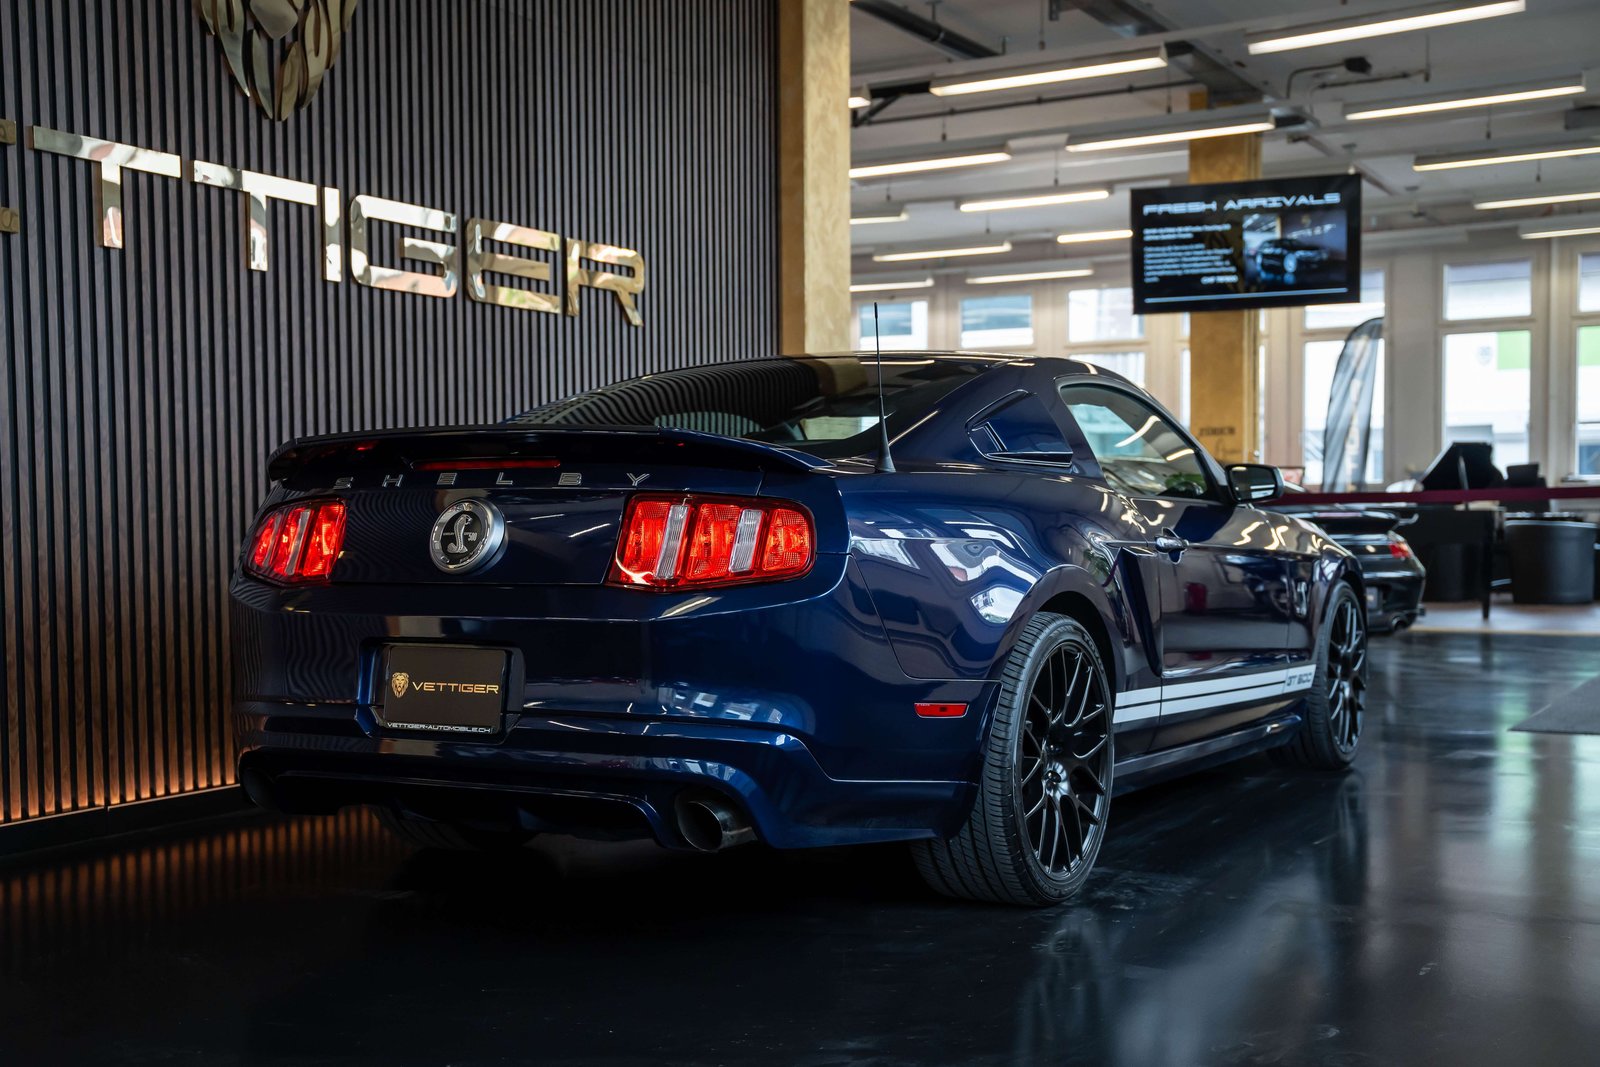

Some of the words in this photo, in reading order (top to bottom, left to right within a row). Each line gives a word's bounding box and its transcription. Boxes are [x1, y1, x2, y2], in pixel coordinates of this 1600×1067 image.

[1143, 200, 1217, 216] FRESH
[1223, 192, 1341, 212] ARRIVALS
[0, 118, 645, 327] TTIGER
[333, 472, 649, 490] SHELBY
[412, 681, 499, 694] VETTIGER
[387, 722, 491, 734] VETTIGER-AUTOMOBILE.CH
